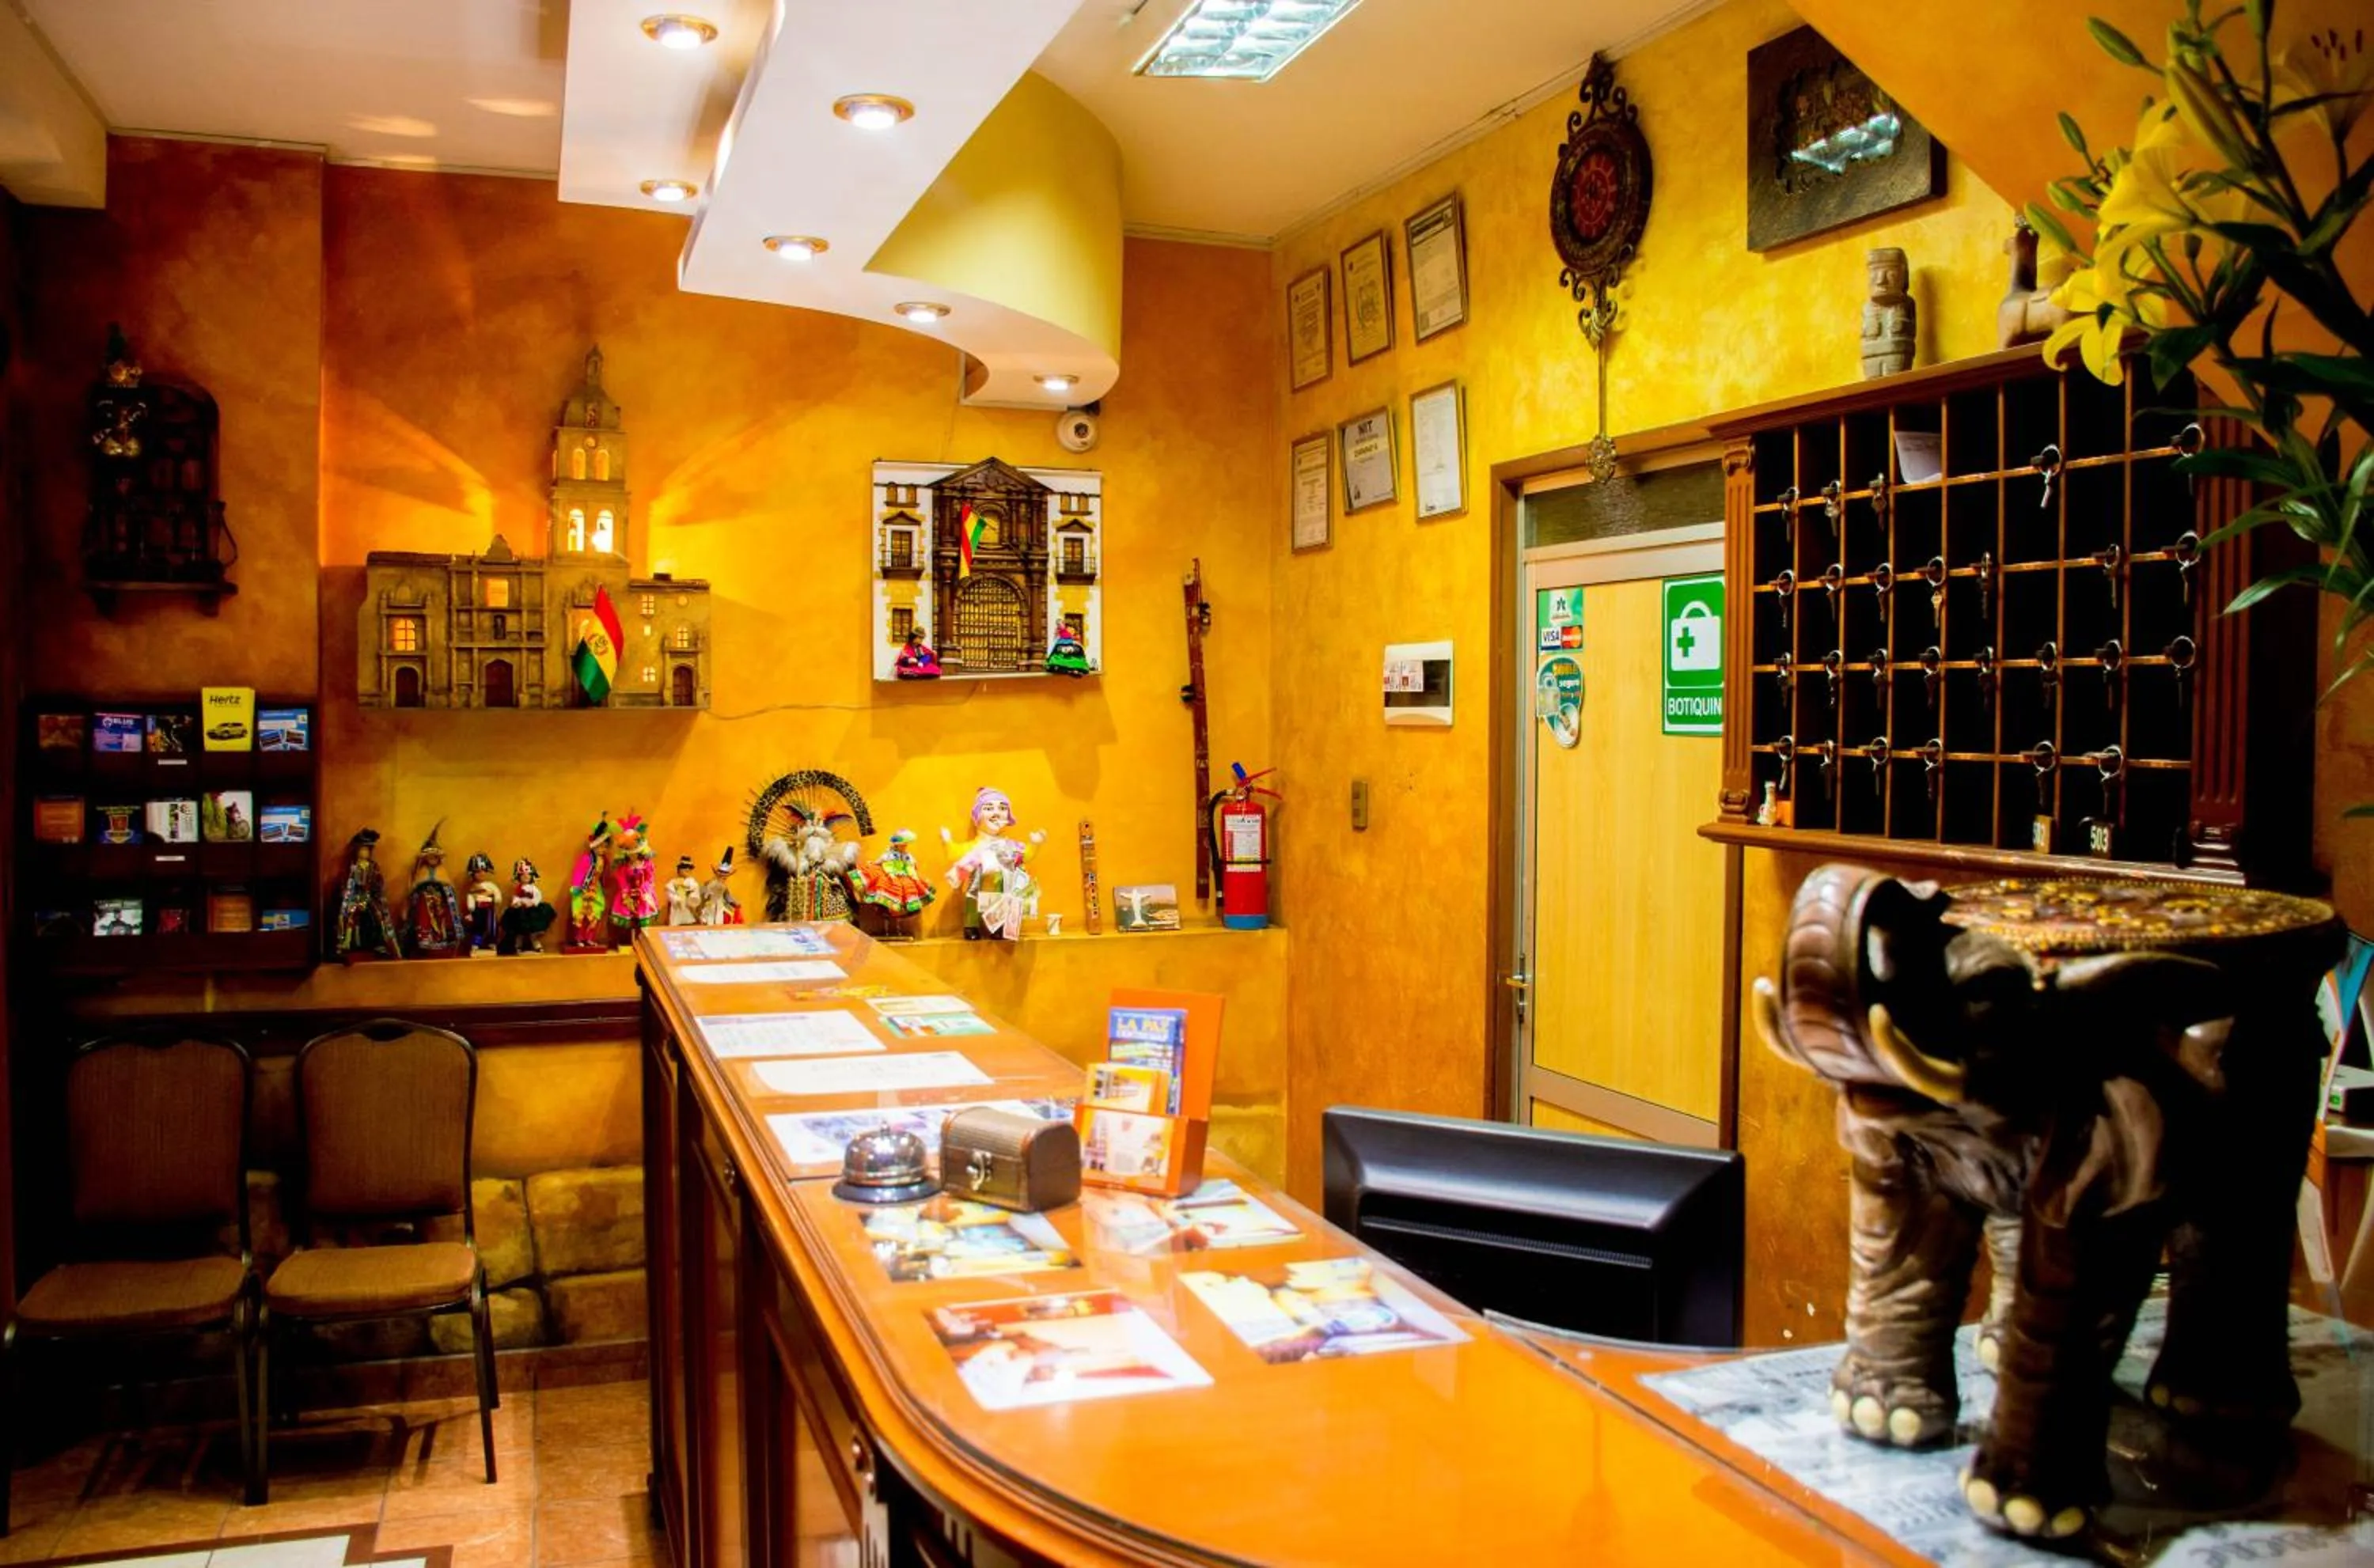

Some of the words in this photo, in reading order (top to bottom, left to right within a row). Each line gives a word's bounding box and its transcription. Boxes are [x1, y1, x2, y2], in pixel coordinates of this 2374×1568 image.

[1544, 630, 1560, 642] VISA
[209, 694, 241, 705] Hertz
[1667, 695, 1722, 717] BOTIQUIN
[2090, 824, 2109, 852] 503
